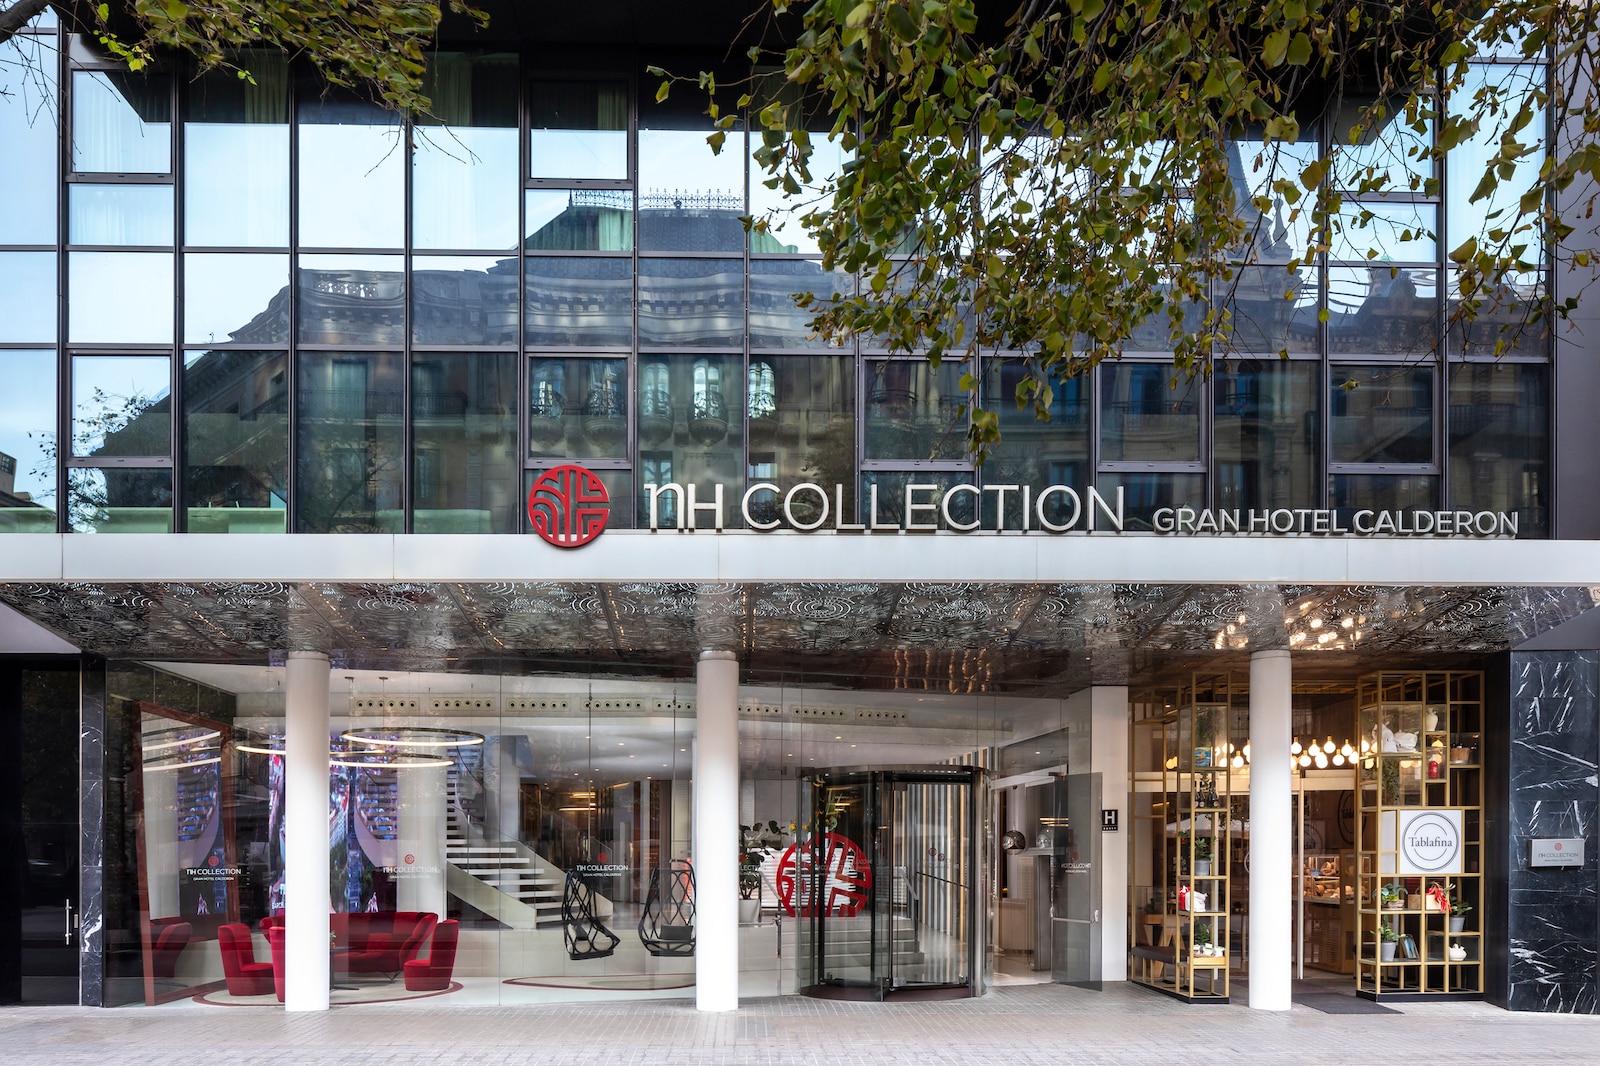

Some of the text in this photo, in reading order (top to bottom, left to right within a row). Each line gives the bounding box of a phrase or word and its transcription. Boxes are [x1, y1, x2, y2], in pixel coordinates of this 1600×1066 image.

[742, 483, 1124, 532] COLLECTION
[1152, 507, 1519, 538] GRAN HOTEL CALDERON
[1104, 810, 1116, 825] H
[1408, 836, 1453, 847] Tablafina
